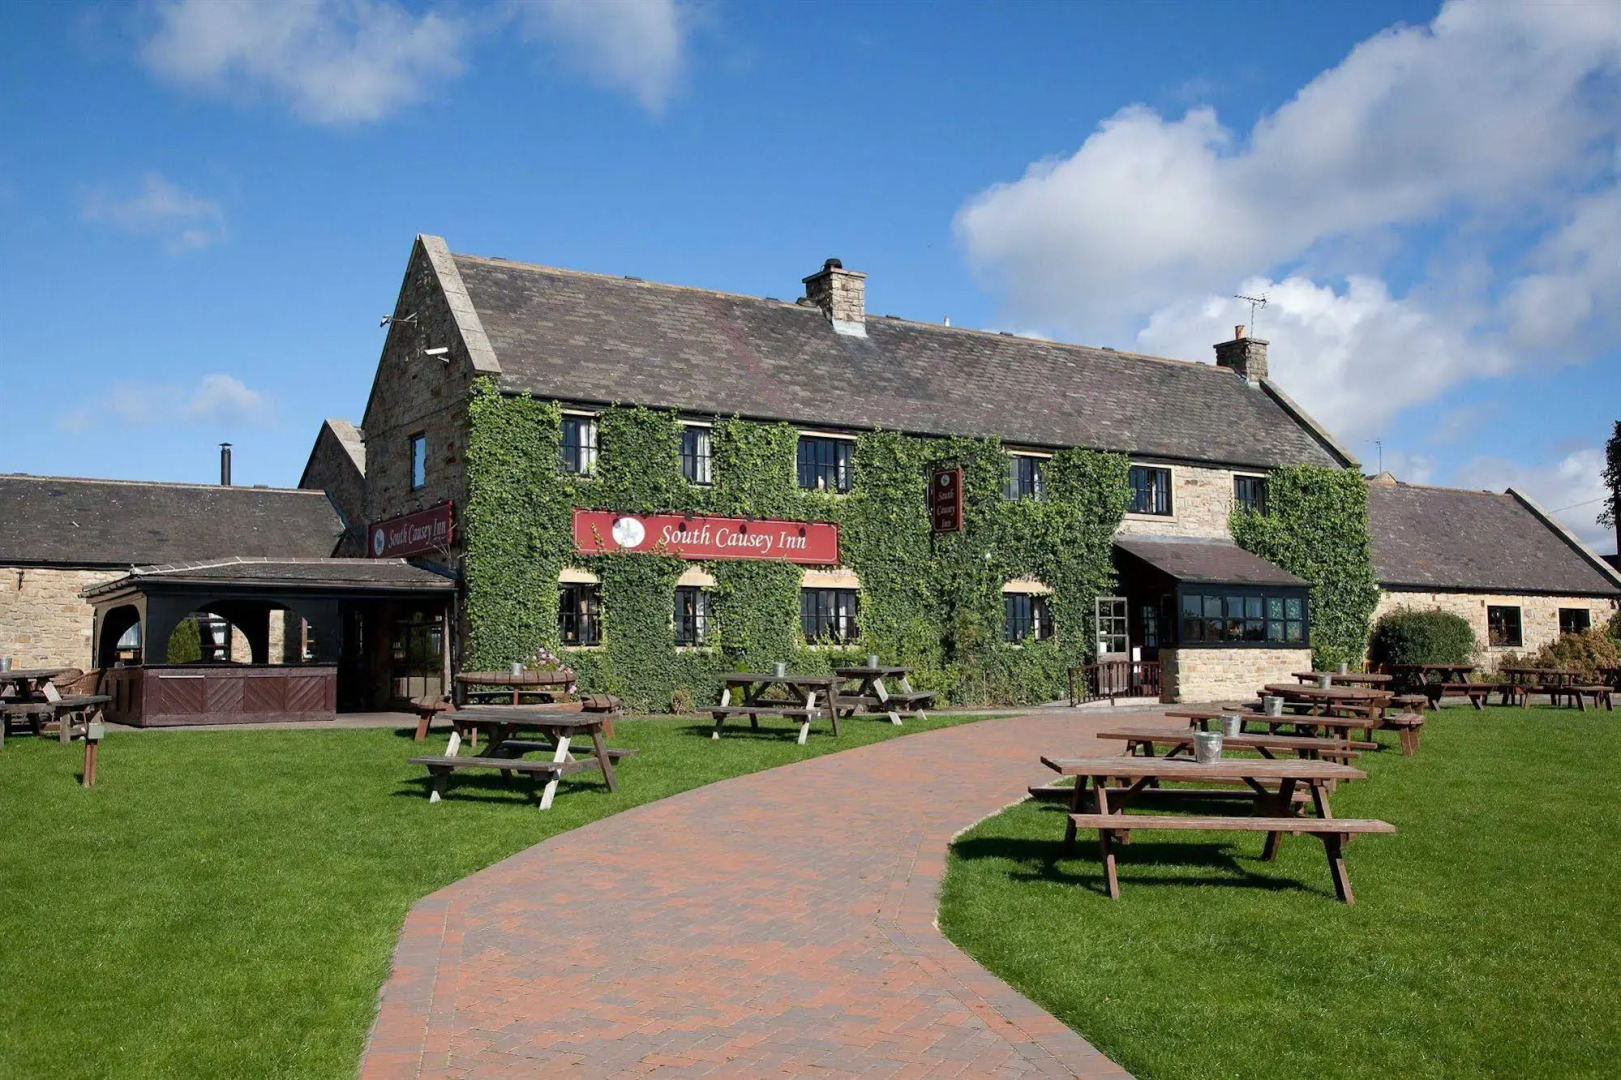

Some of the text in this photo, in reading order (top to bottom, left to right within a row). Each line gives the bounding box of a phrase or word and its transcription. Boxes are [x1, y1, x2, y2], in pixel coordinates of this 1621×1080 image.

[388, 518, 447, 549] South Causey Inn
[659, 524, 806, 554] South Causey Inn
